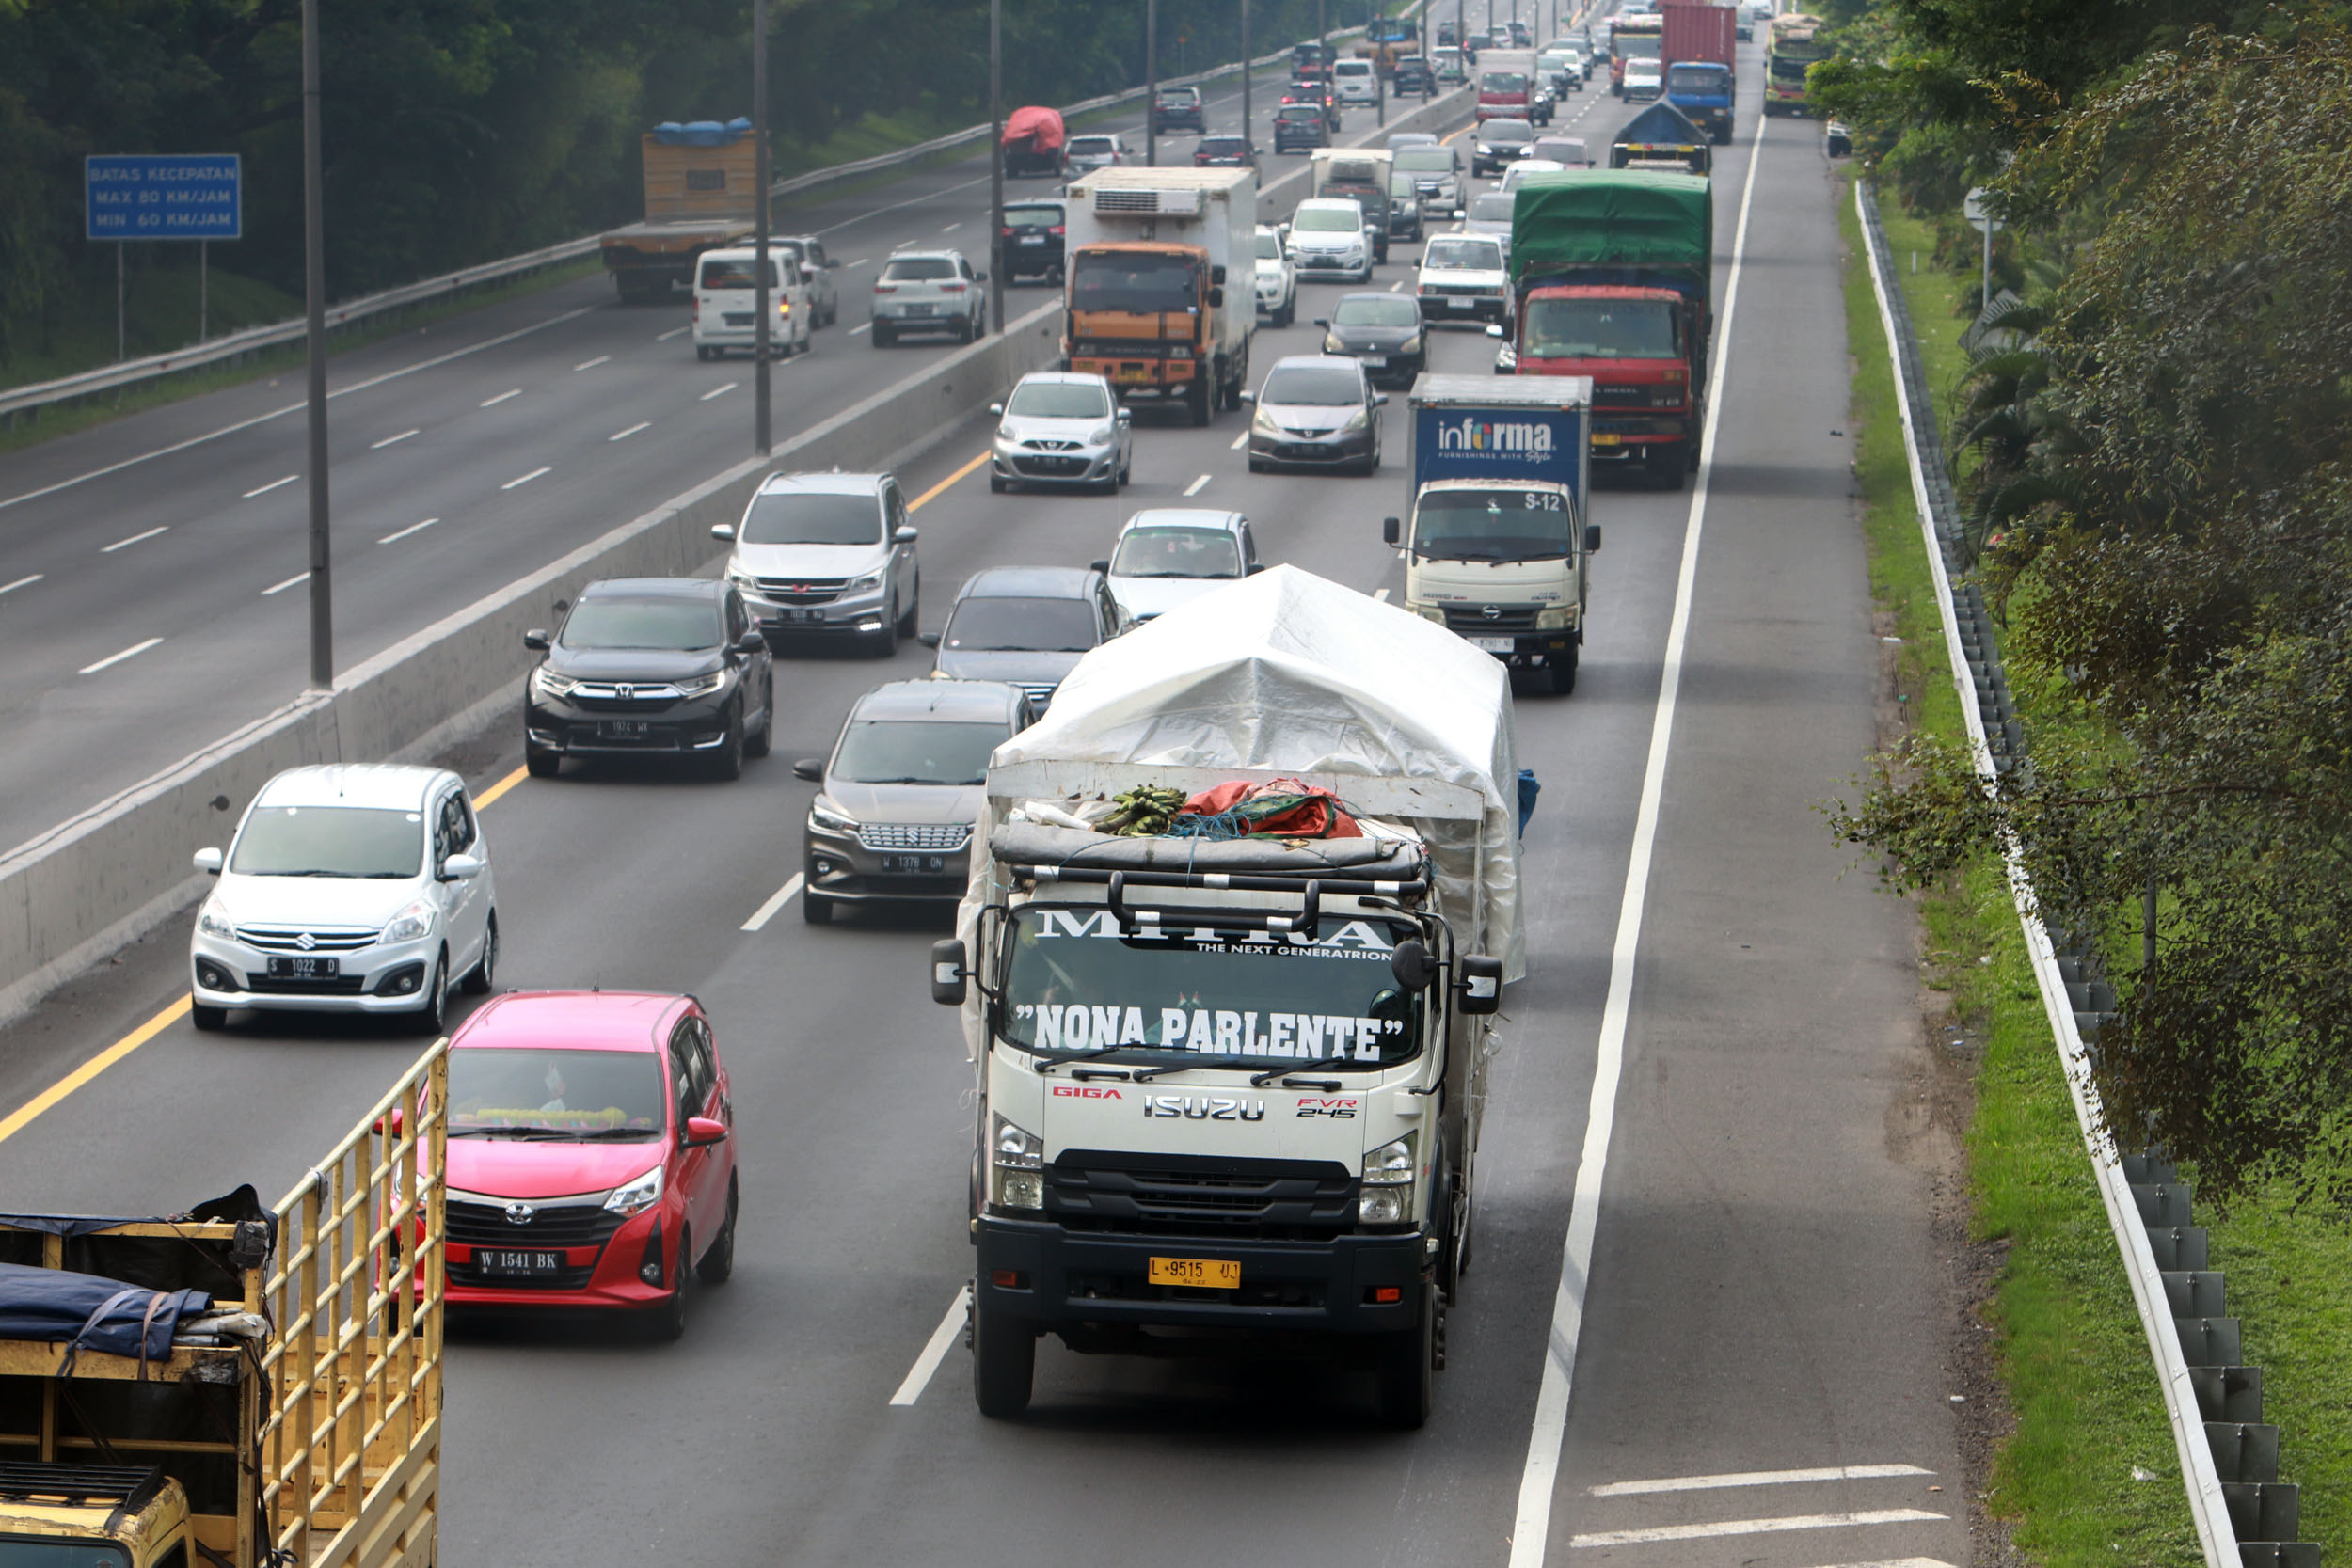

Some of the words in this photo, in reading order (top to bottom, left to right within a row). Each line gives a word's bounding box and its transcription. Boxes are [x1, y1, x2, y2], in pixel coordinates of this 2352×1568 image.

[89, 167, 140, 182] BATAS
[147, 166, 235, 181] KECEPATAN
[96, 190, 132, 203] MAX
[138, 190, 160, 203] 80
[166, 190, 230, 203] KM/JAM
[96, 214, 126, 227] MIN
[137, 213, 160, 227] 60
[166, 213, 231, 227] KM/JAM
[1438, 417, 1552, 451] informa
[1524, 450, 1551, 465] Style
[1525, 493, 1560, 512] S-12
[1196, 942, 1226, 953] THE
[1231, 944, 1273, 955] NEXT
[1277, 946, 1392, 961] GENERATRION
[270, 958, 278, 972] S
[292, 958, 316, 972] 1022
[327, 958, 335, 972] D
[1053, 1086, 1122, 1100] GIGA
[1144, 1095, 1265, 1121] ISUZU
[1296, 1098, 1358, 1108] FVR
[1296, 1108, 1358, 1119] 245
[481, 1251, 494, 1266] W
[501, 1252, 530, 1268] 1541
[536, 1253, 557, 1268] BK
[1152, 1259, 1159, 1275] L
[1169, 1260, 1203, 1277] 9515
